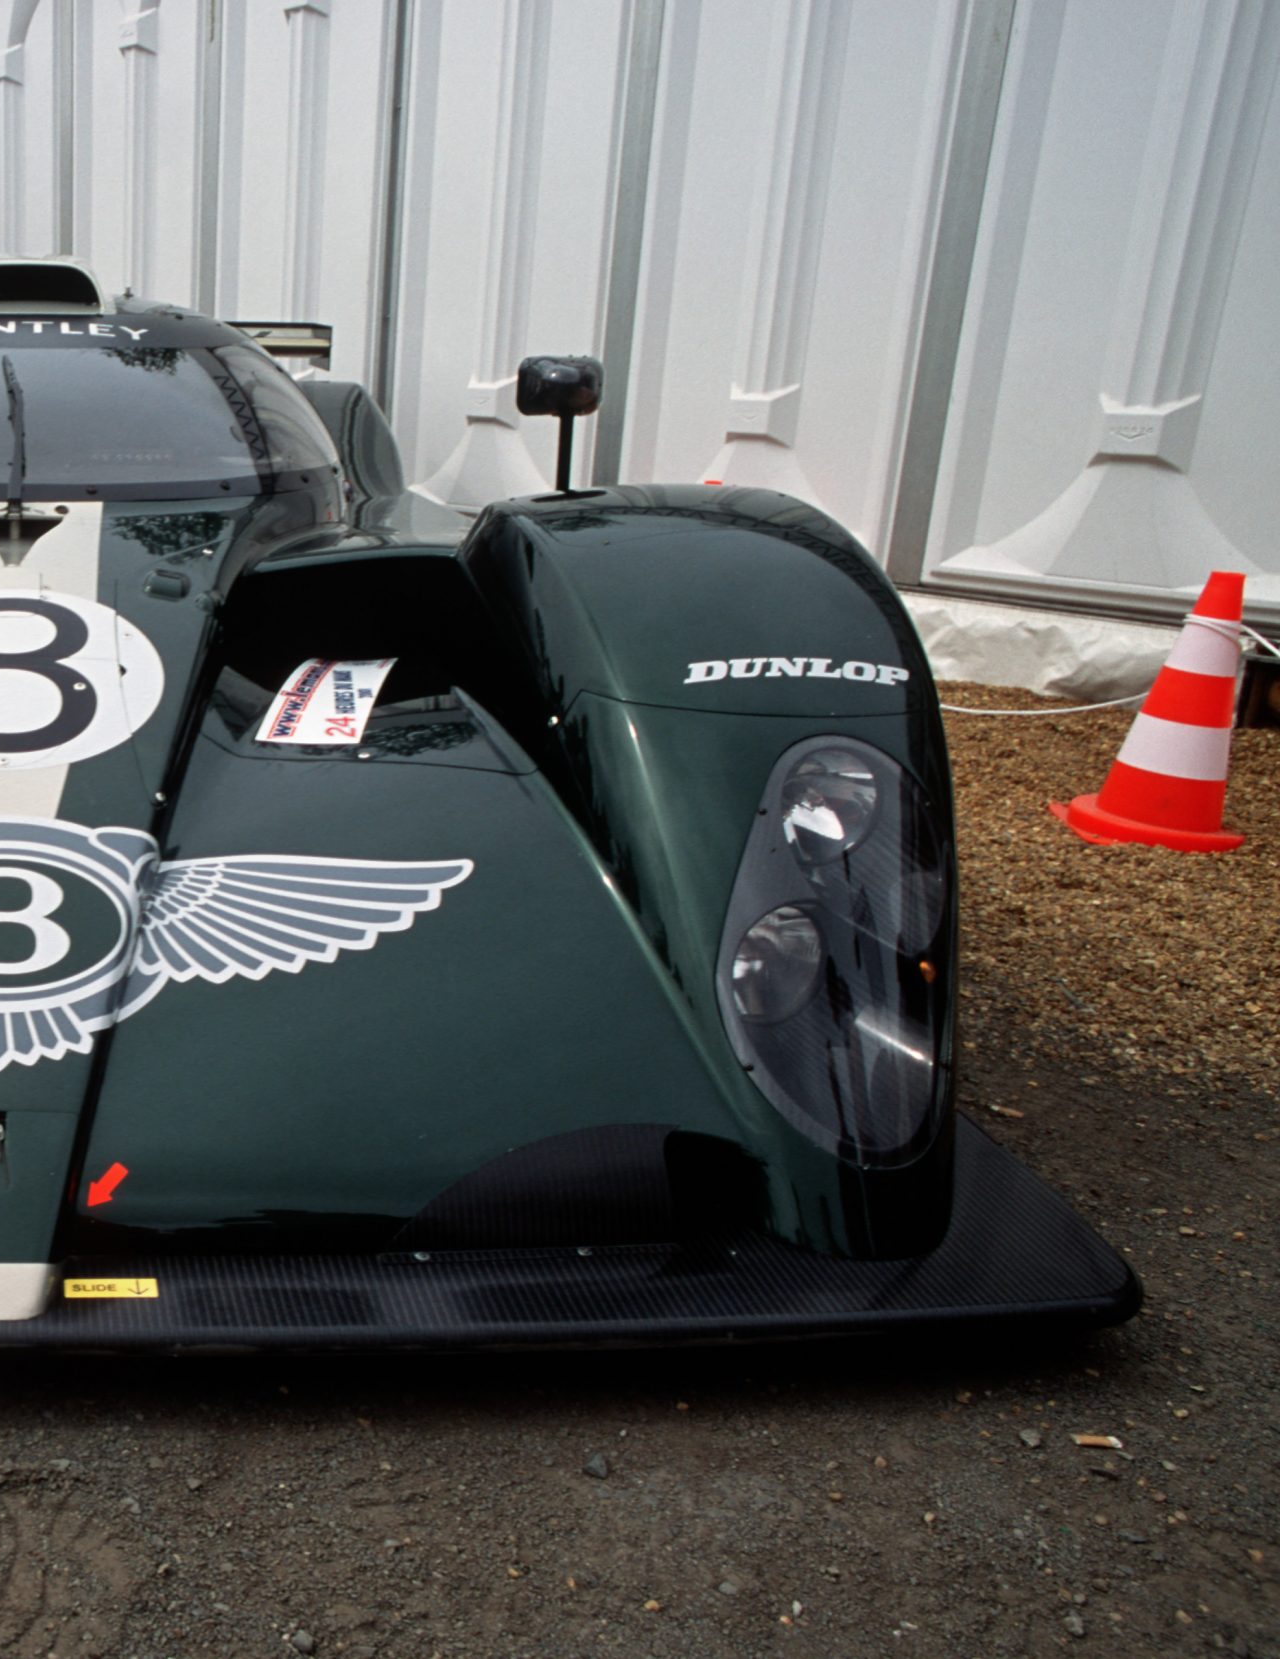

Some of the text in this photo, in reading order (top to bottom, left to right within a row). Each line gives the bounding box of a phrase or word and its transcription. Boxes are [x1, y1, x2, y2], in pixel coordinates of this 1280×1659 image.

[683, 657, 910, 686] DUNLOP
[325, 716, 358, 738] 24
[72, 1284, 117, 1292] SLIDE
